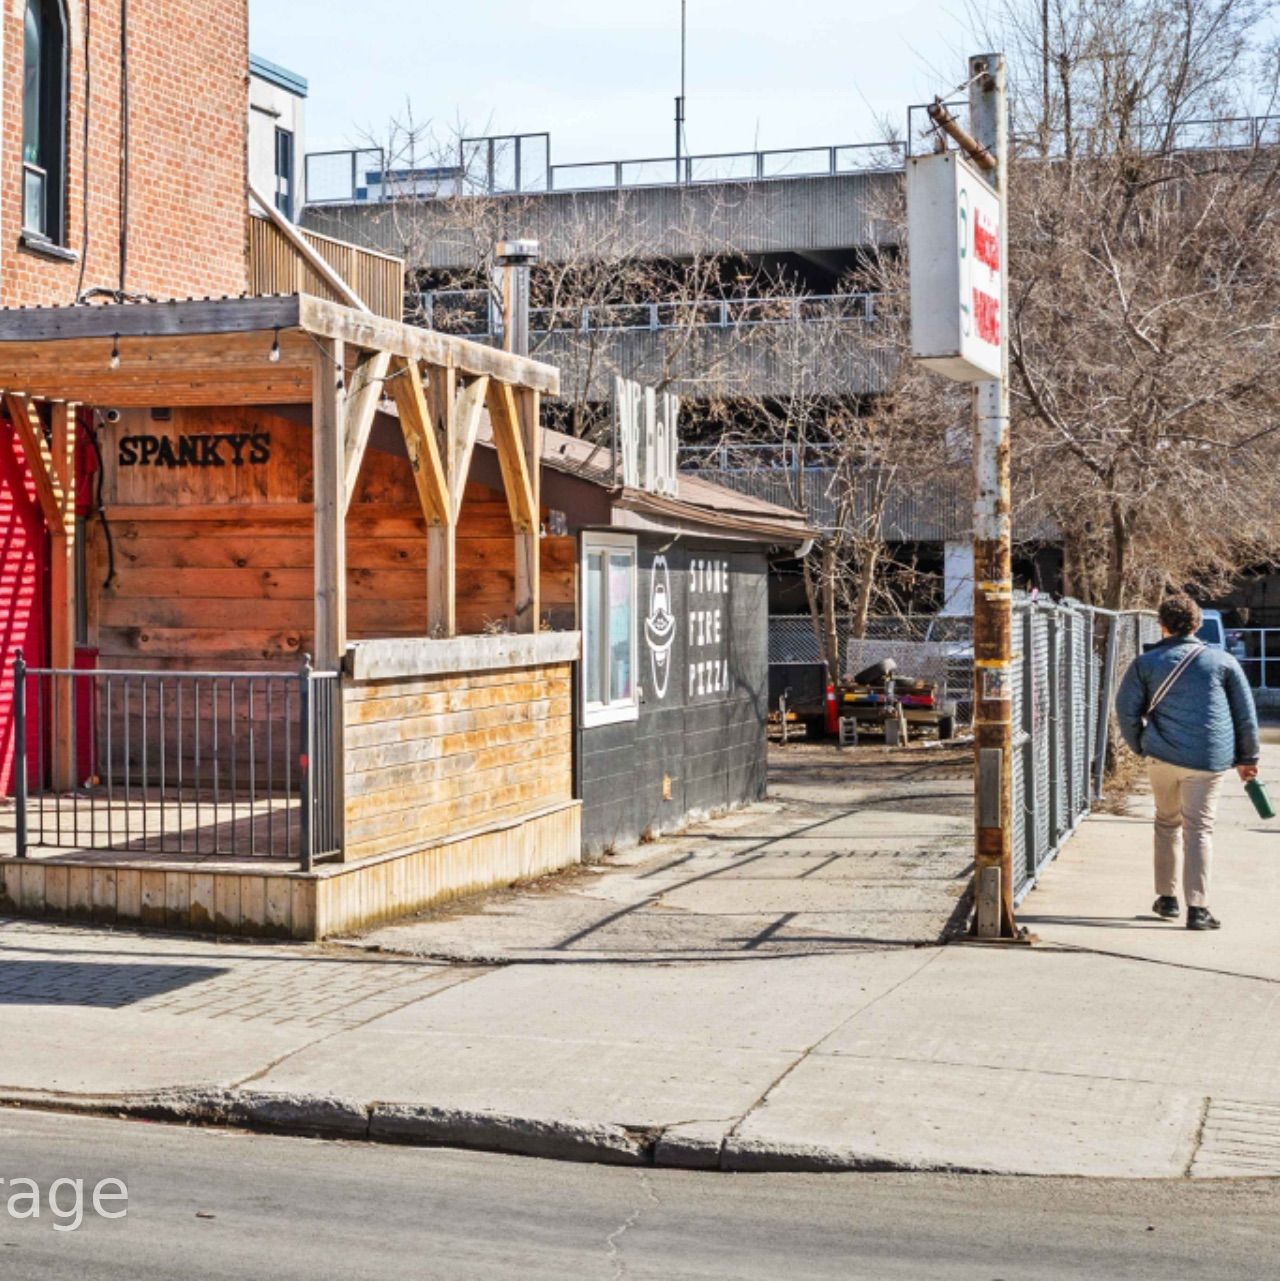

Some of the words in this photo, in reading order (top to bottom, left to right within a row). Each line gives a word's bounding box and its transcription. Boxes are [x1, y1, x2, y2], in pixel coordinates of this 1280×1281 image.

[690, 559, 728, 593] STONE
[690, 609, 721, 646] FIRE
[690, 659, 729, 697] PIZZA
